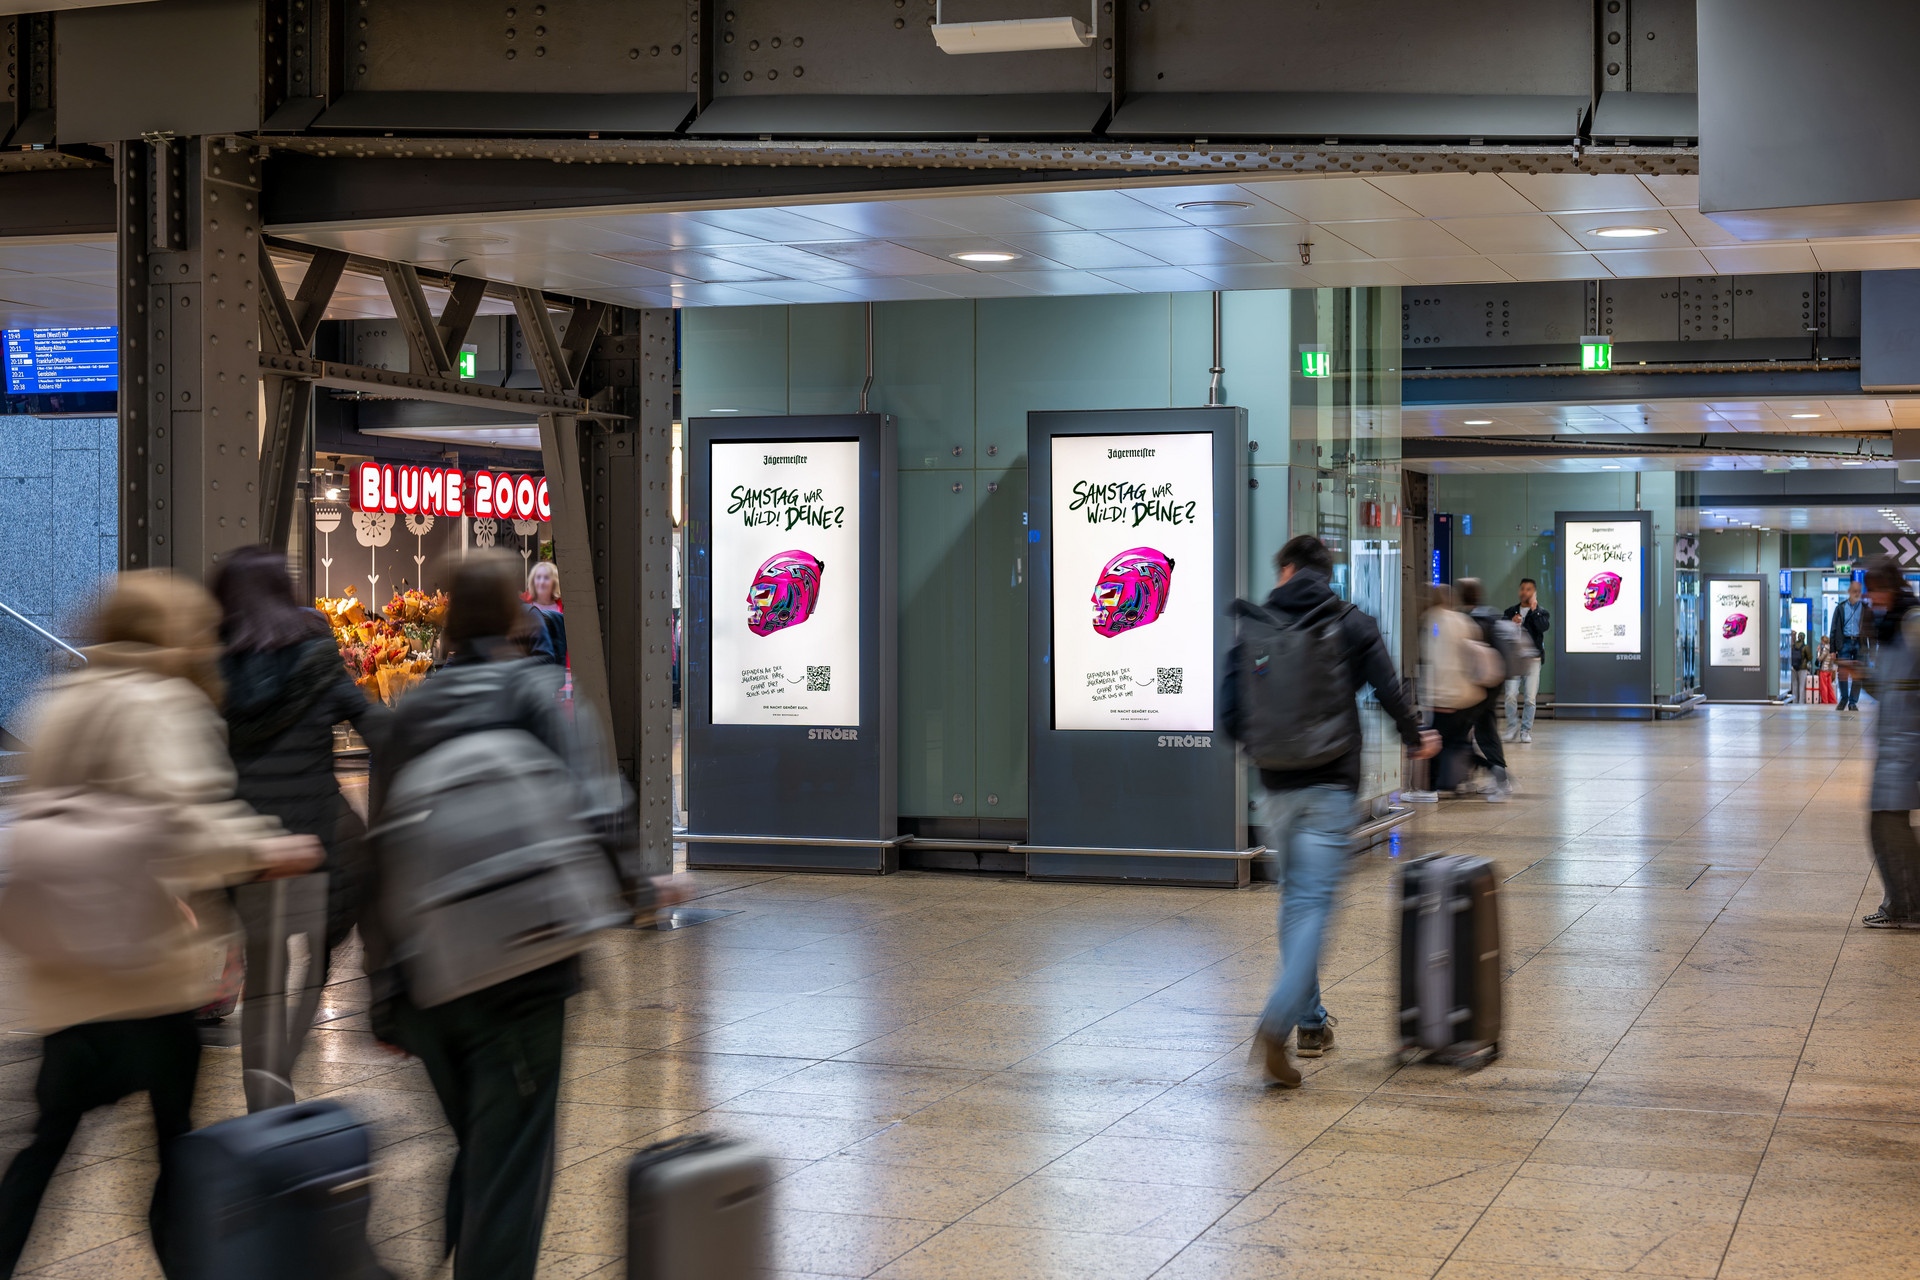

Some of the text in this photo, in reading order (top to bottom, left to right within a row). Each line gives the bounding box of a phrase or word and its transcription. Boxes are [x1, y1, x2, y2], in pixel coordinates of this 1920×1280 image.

[360, 463, 463, 517] BLUME
[728, 485, 824, 514] SAMSTAG WAR
[1069, 480, 1173, 510] SAMSTAG WAR
[785, 505, 844, 531] DEINE?
[1132, 500, 1196, 528] DEINE?
[1574, 542, 1610, 555] SAMSTAG
[808, 728, 858, 740] STRÖER
[1158, 735, 1211, 748] STRÖER
